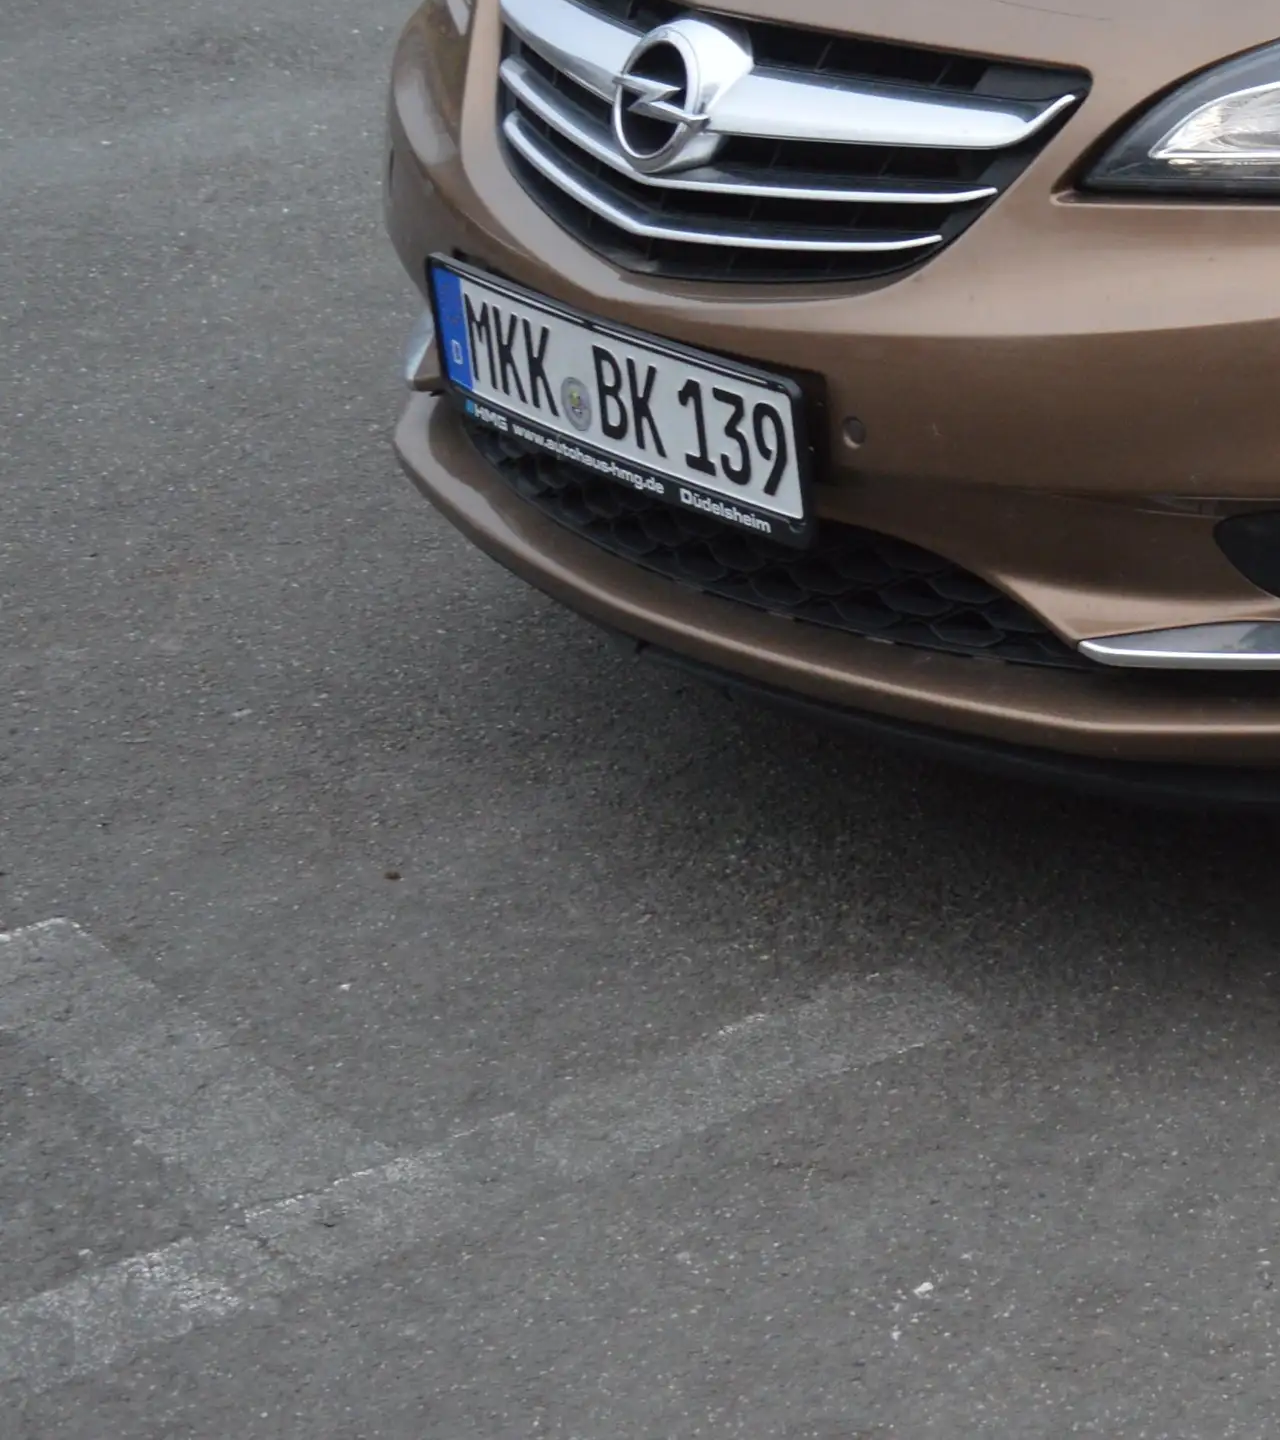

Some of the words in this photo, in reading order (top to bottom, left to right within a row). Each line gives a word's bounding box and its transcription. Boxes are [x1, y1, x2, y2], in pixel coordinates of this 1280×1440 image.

[464, 292, 559, 418] MKK
[592, 343, 667, 459] BK
[678, 378, 788, 497] 139
[513, 423, 665, 495] www.autohaus-hmg.de
[680, 486, 772, 534] Düdelsheim
